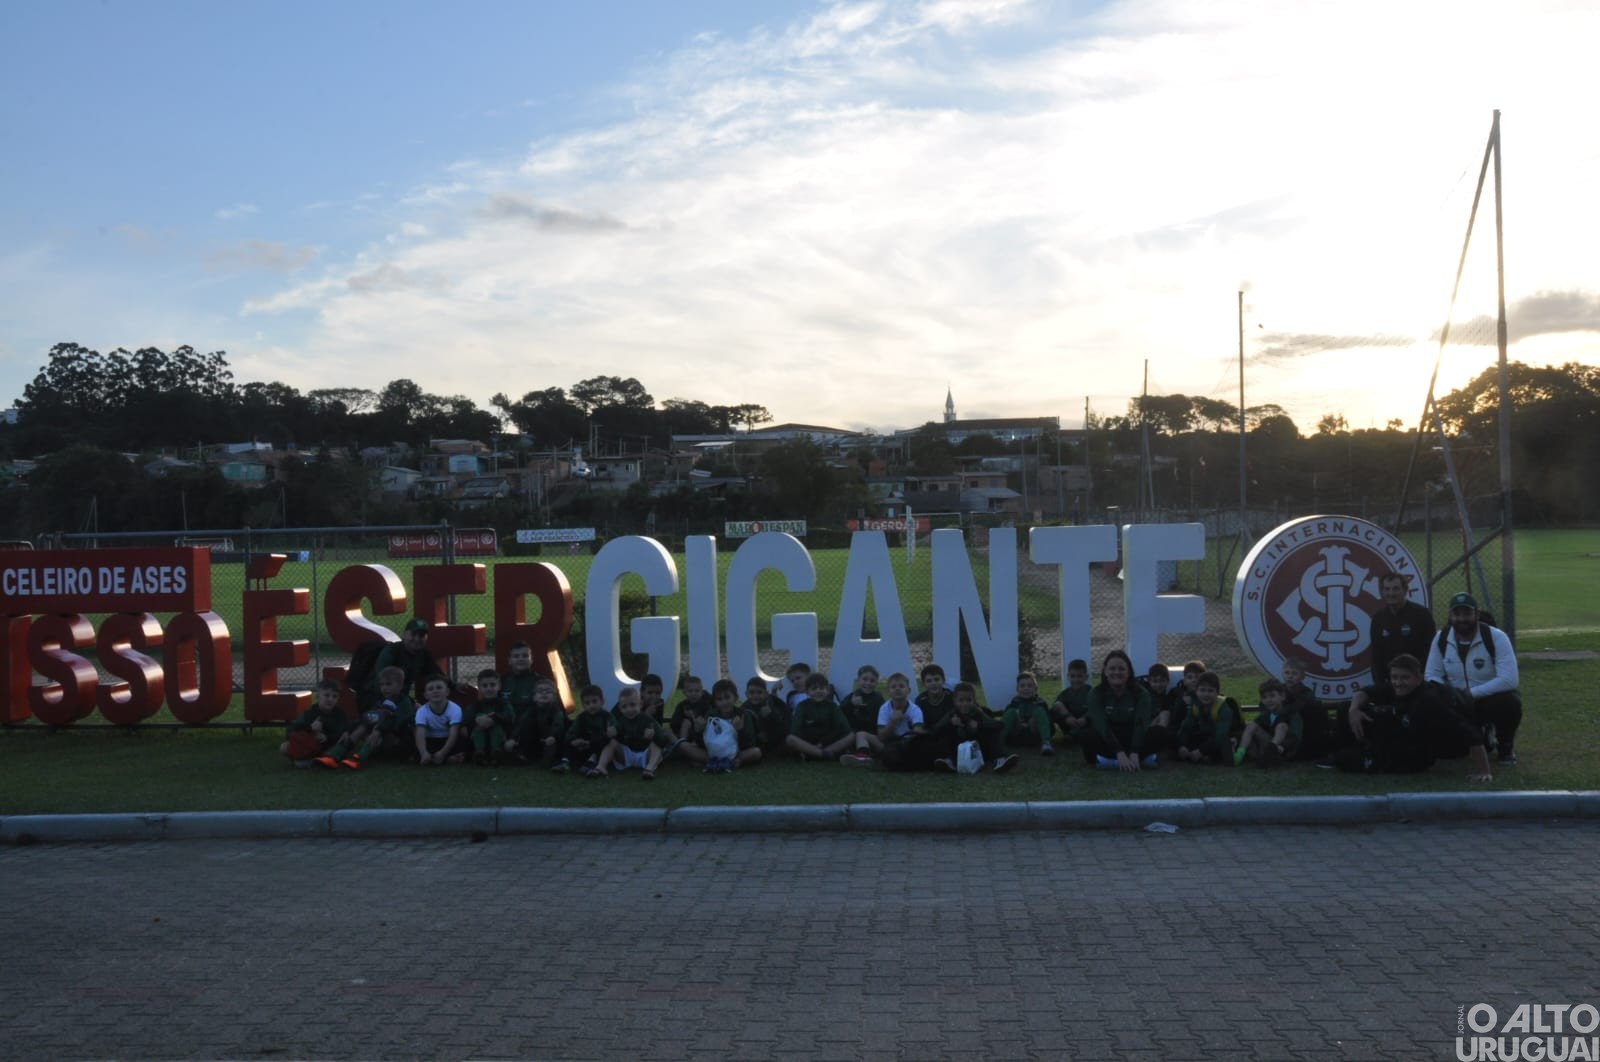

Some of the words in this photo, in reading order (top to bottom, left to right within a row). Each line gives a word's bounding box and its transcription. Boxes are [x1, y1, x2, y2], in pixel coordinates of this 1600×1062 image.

[2, 566, 94, 597] CELEIRO
[97, 566, 126, 595] DE
[130, 564, 187, 595] ASES
[243, 552, 312, 722] É
[585, 522, 1206, 713] GIGANTE
[1311, 681, 1361, 696] 1909
